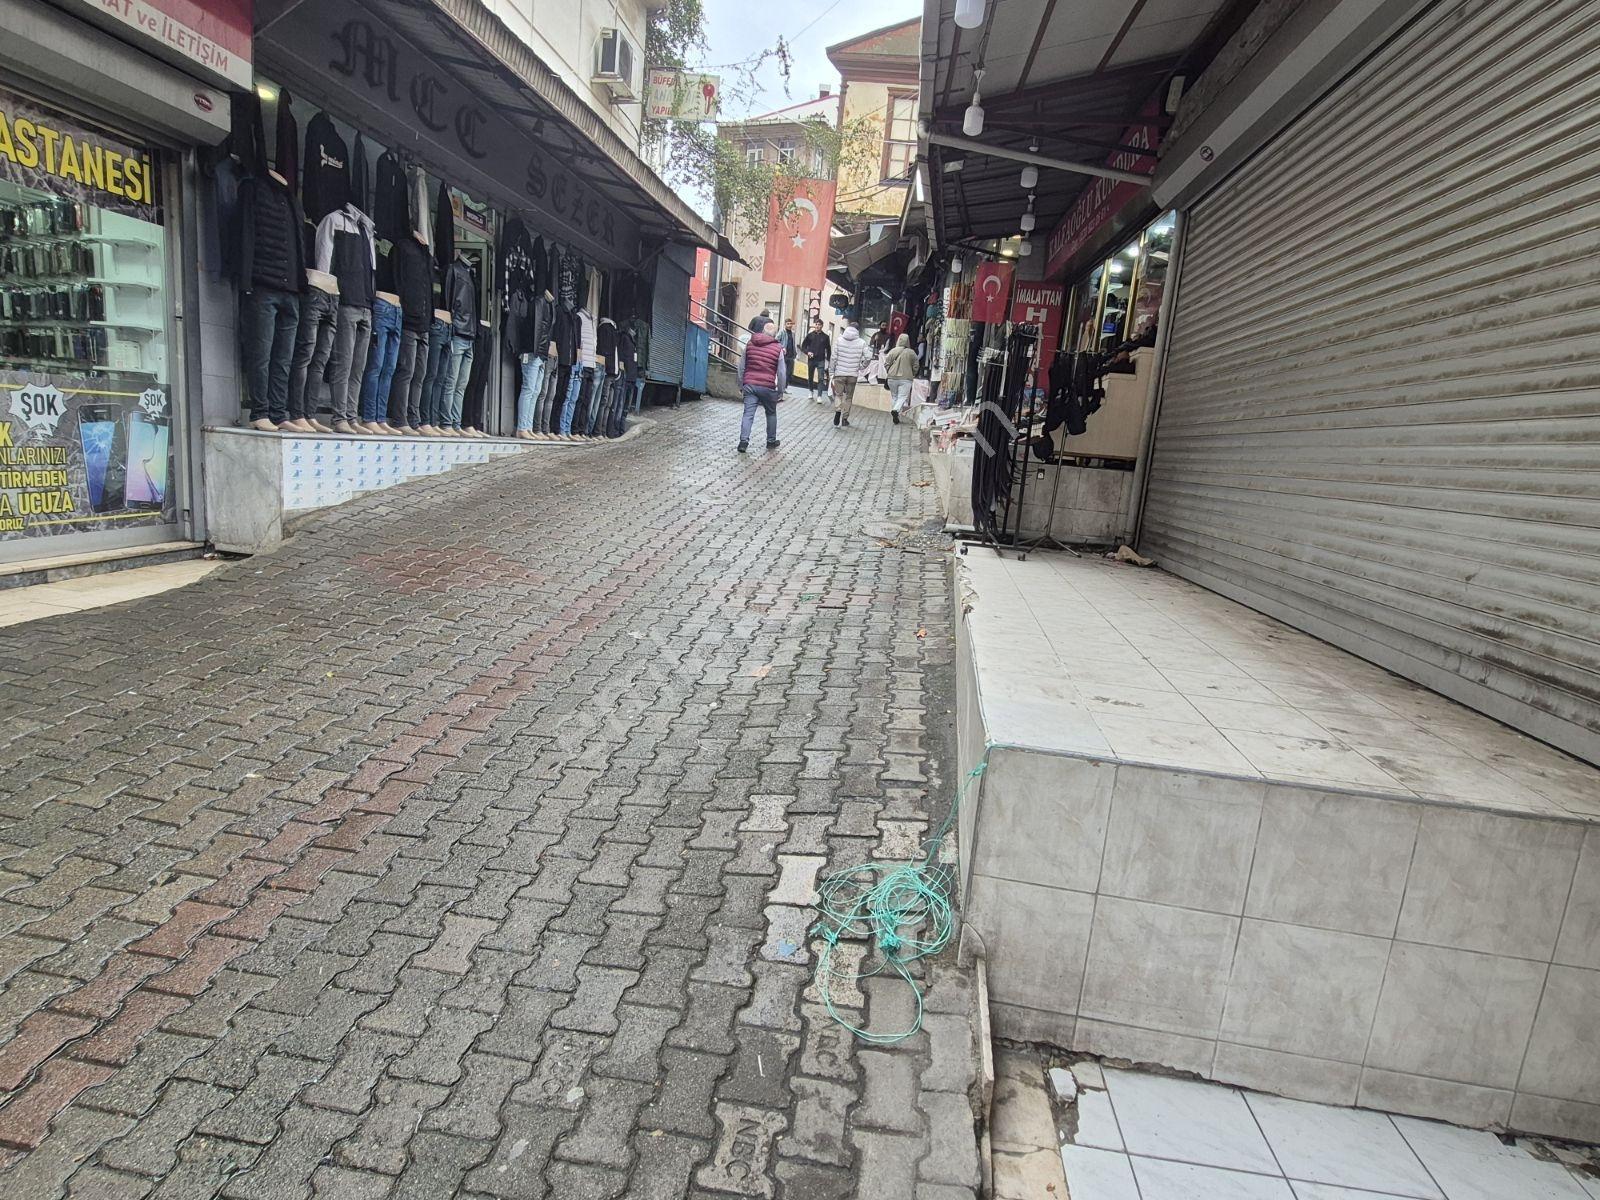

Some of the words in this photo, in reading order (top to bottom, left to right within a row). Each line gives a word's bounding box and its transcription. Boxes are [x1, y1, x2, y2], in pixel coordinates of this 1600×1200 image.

[137, 9, 157, 32] ve
[161, 16, 229, 72] İLETİŞİM
[1016, 284, 1062, 307] İMALATTAN
[21, 392, 59, 421] ŞOK
[143, 394, 163, 409] ŞOK
[0, 468, 68, 488] TİRMEDEN
[18, 491, 75, 515] UCUZA
[0, 517, 25, 531] ORUZ
